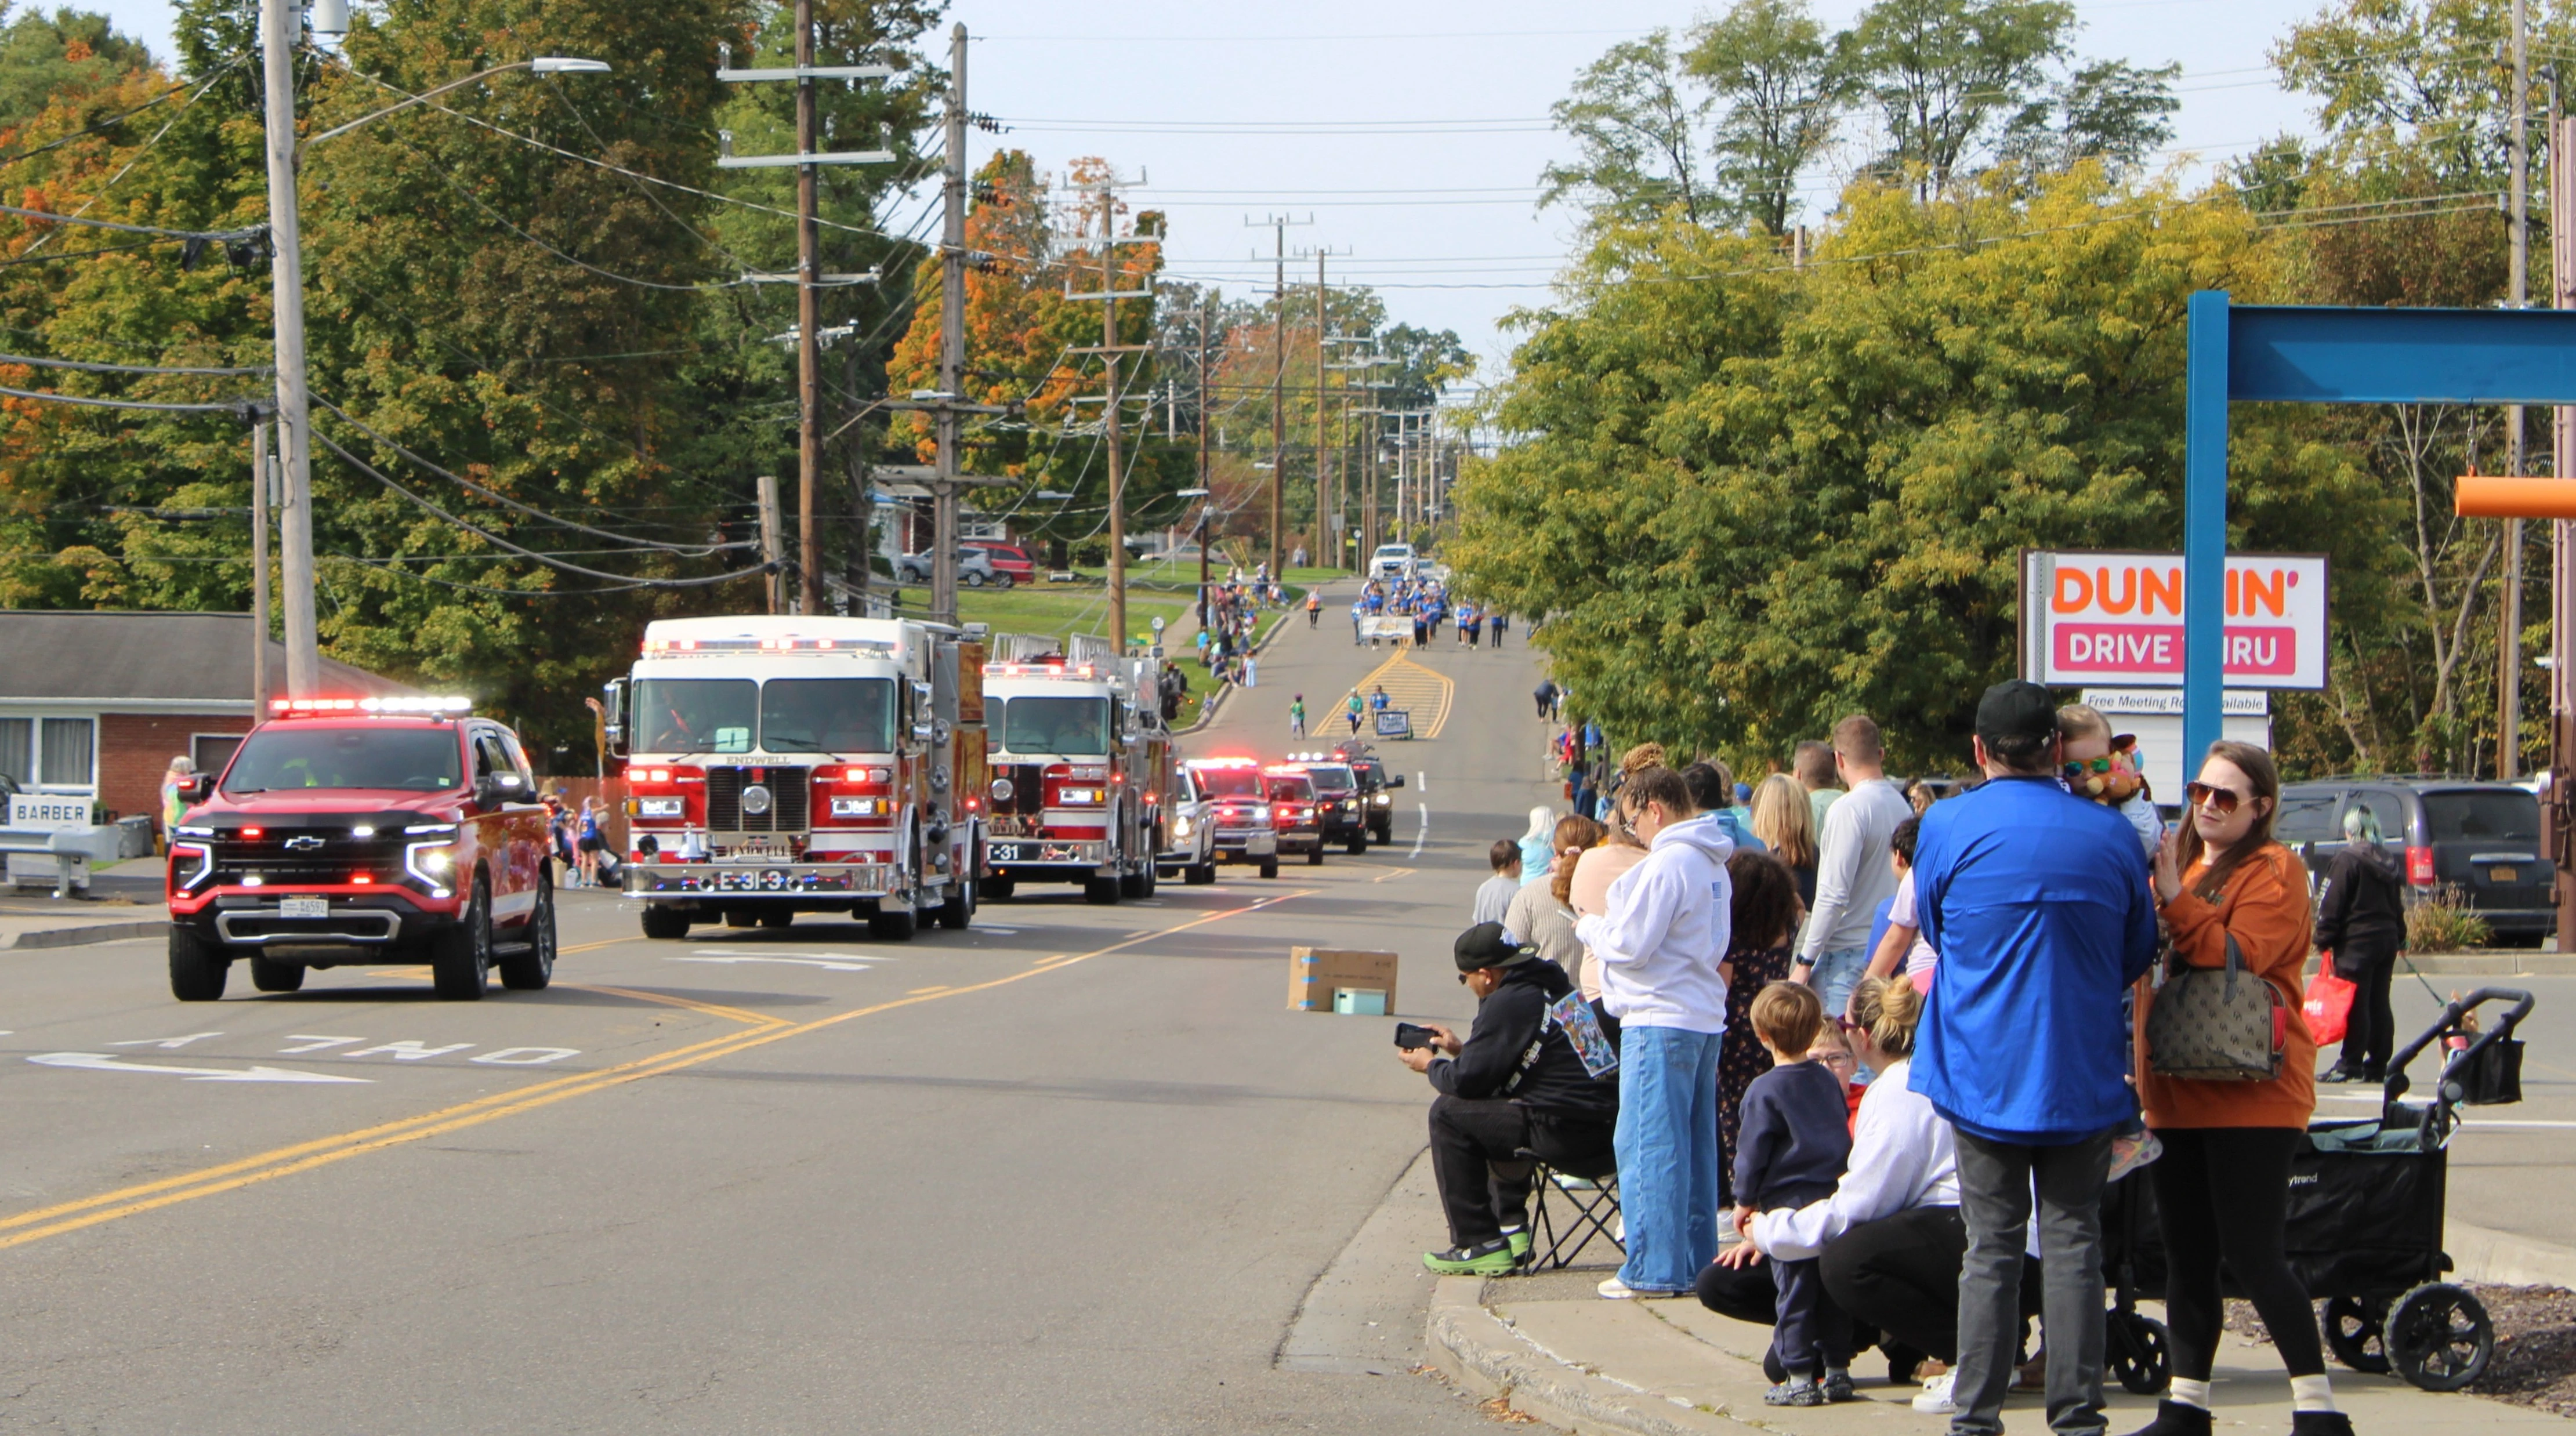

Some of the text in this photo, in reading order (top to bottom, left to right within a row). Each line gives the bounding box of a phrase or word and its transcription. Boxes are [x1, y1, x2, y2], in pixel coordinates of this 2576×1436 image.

[2051, 567, 2299, 620] DUNIN'
[2070, 633, 2172, 664] DRIVE
[2088, 695, 2263, 710] Free Meeting Ro ailable
[726, 756, 791, 765] ENDWELL
[17, 804, 84, 821] BARBER
[720, 871, 781, 890] E-31-3
[2288, 1172, 2318, 1188] ytrend
